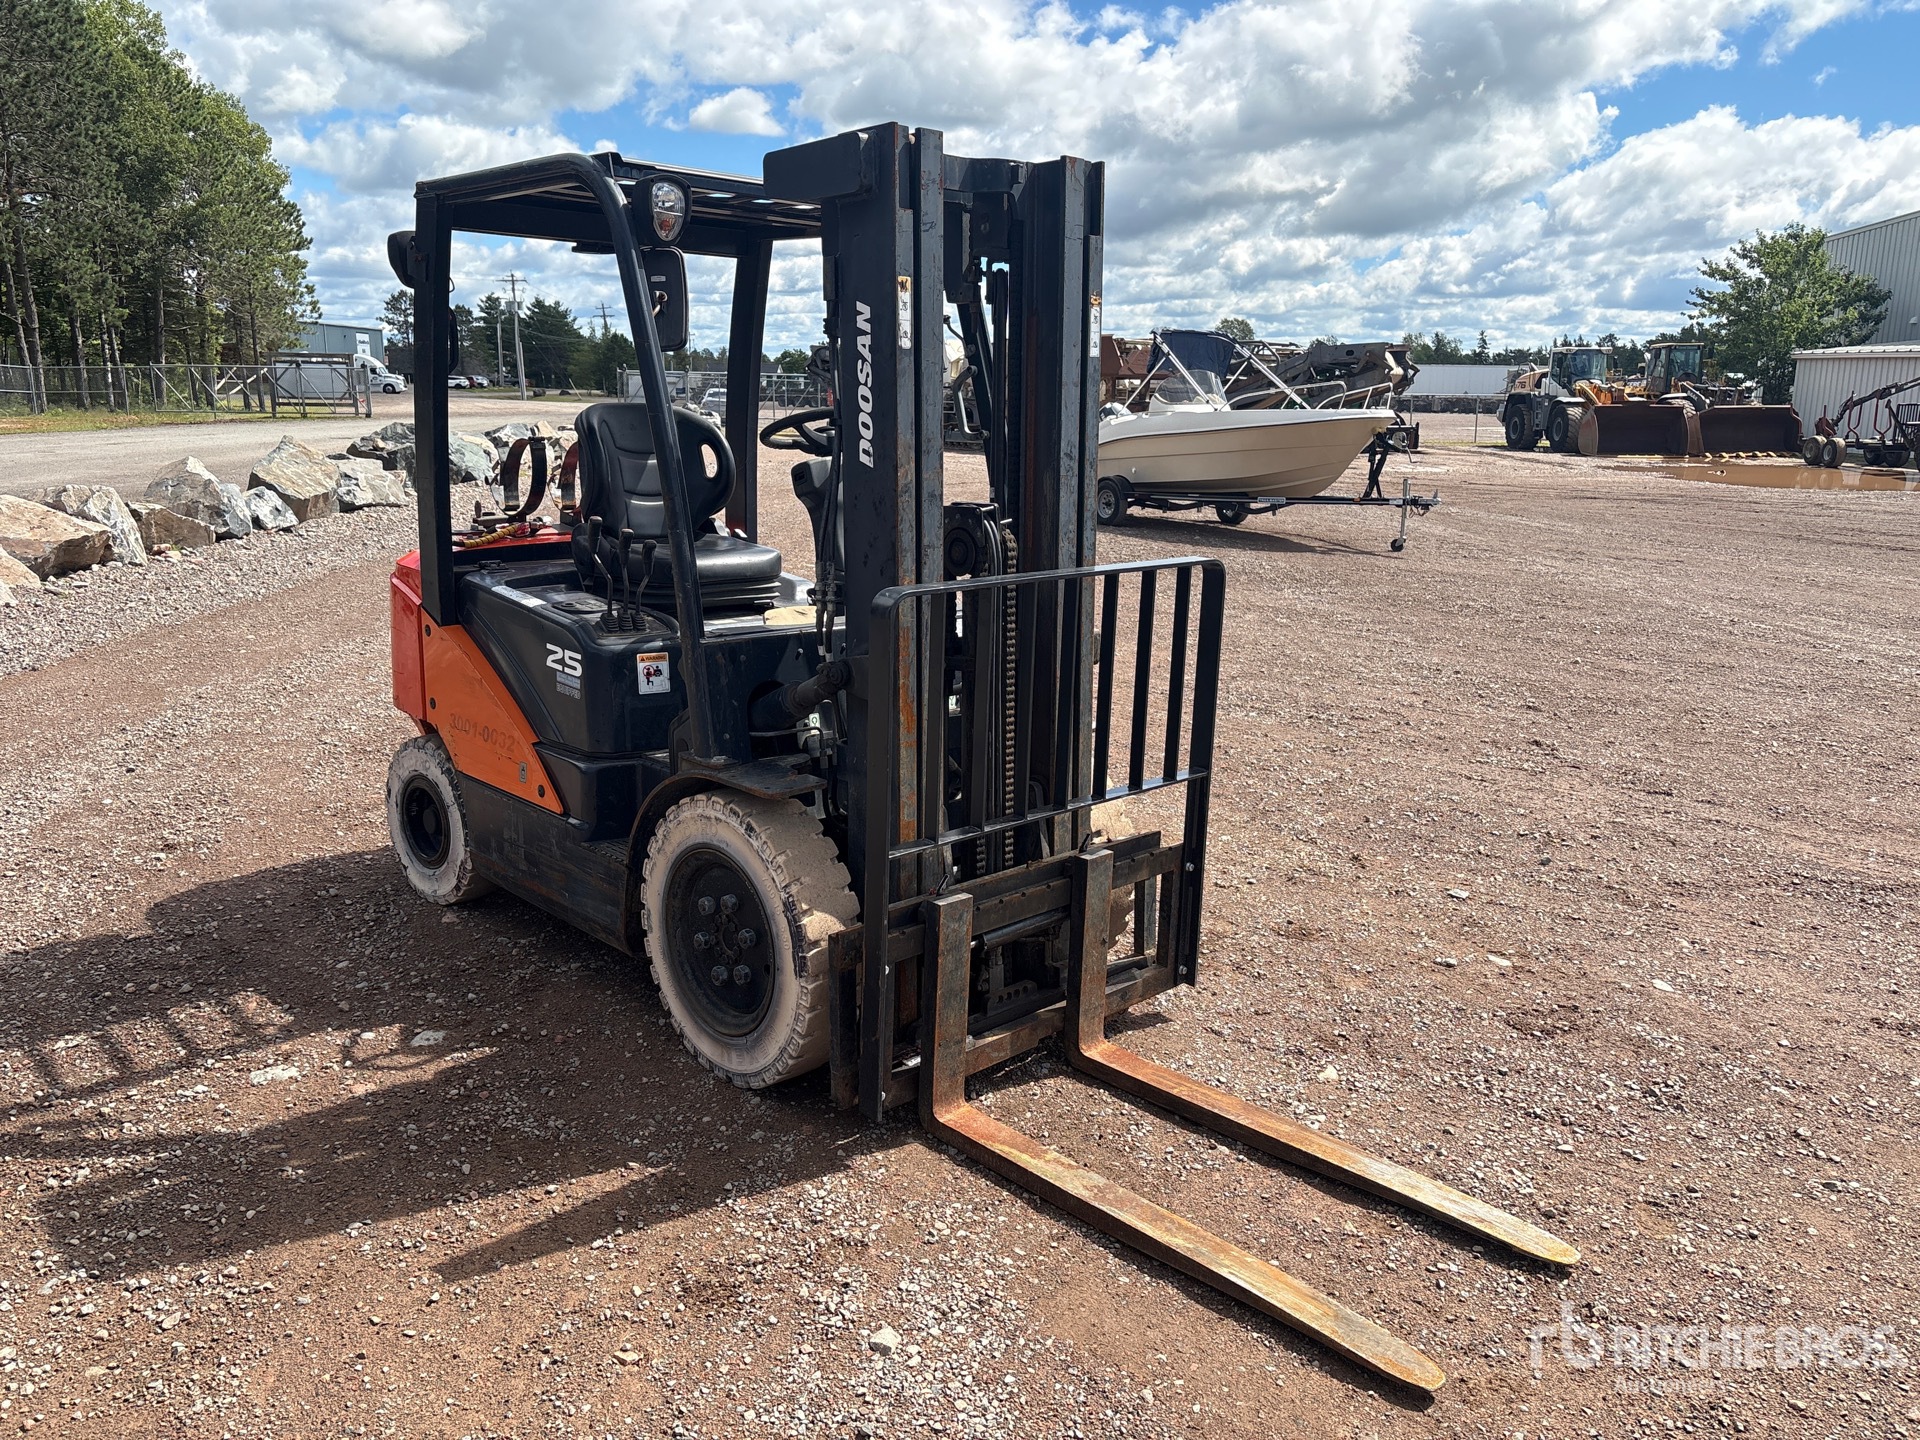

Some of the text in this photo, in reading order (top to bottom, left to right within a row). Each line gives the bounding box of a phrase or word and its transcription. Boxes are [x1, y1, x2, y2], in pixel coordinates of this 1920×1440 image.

[855, 301, 874, 468] DOOSAN
[546, 643, 582, 677] 25
[645, 654, 667, 662] WARNING
